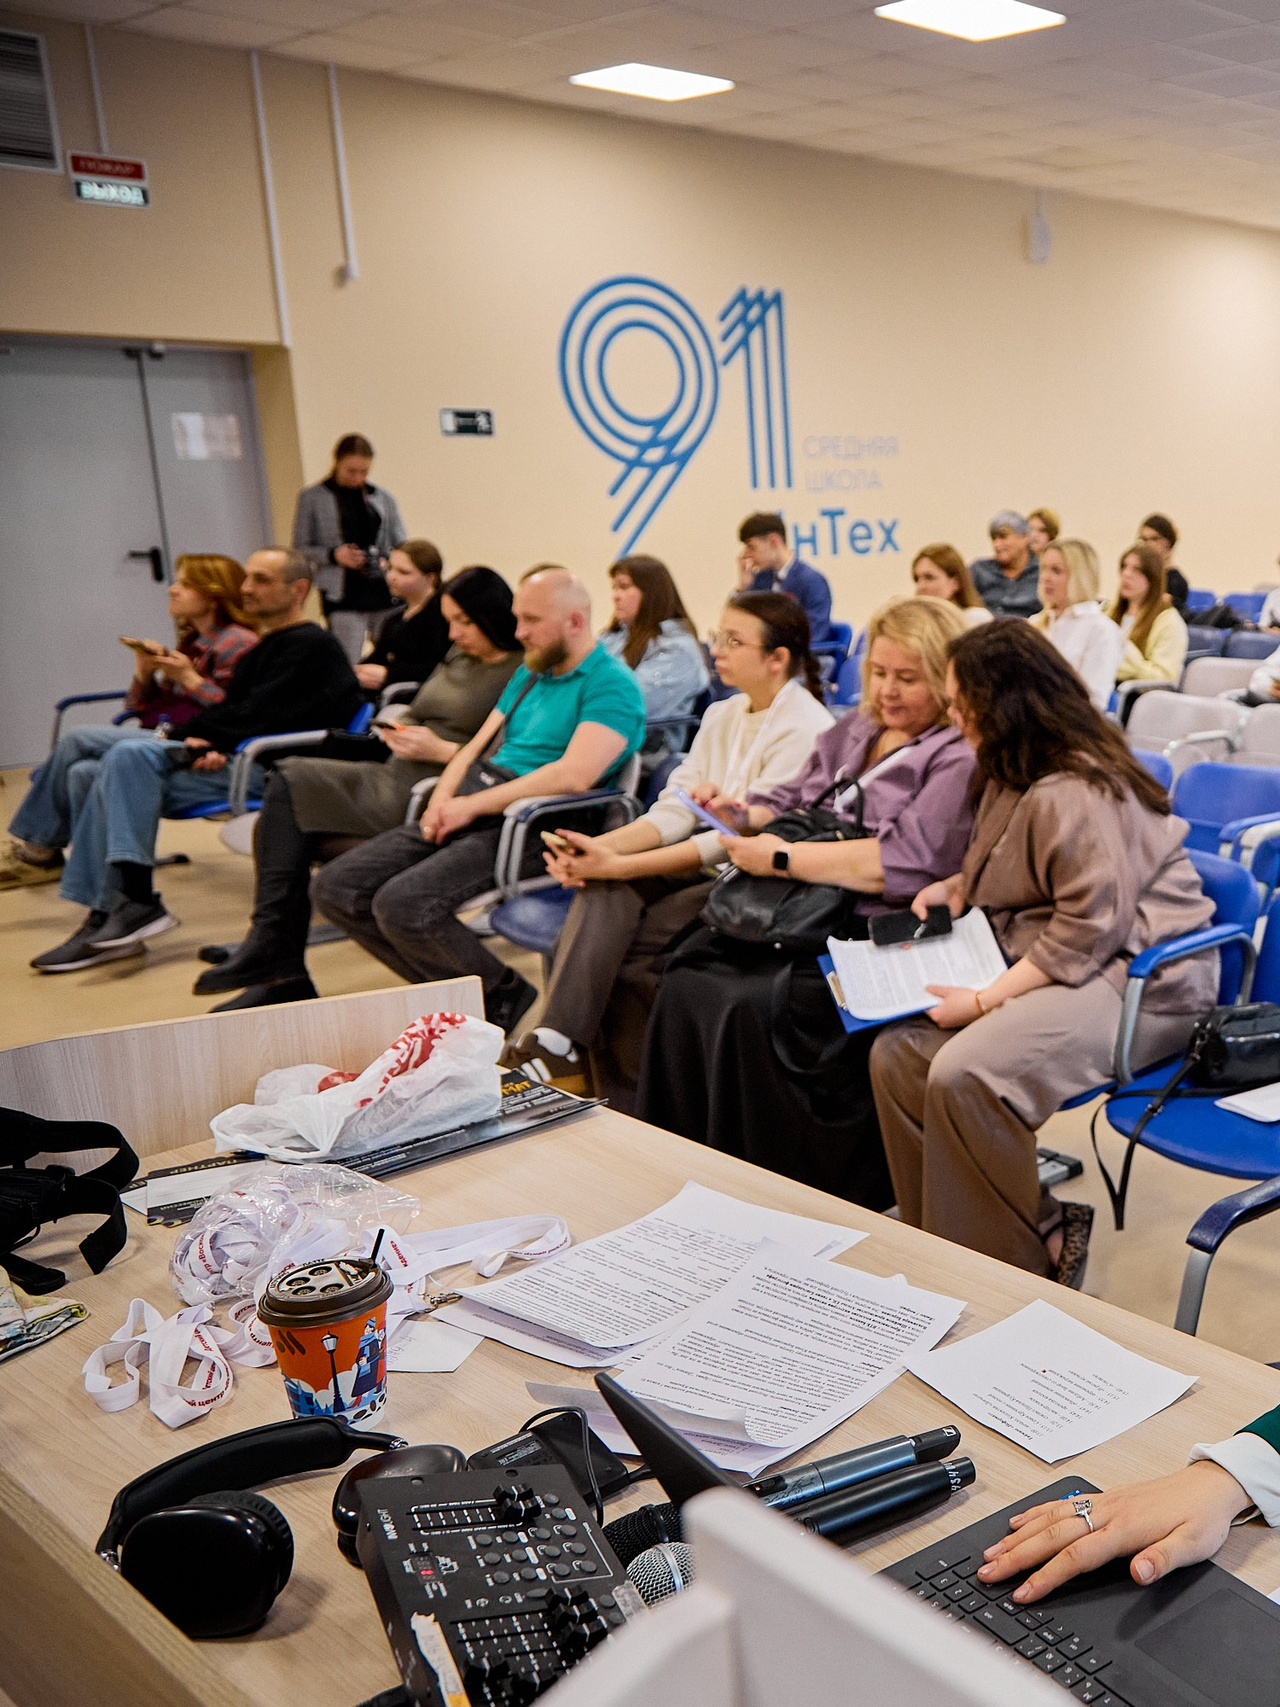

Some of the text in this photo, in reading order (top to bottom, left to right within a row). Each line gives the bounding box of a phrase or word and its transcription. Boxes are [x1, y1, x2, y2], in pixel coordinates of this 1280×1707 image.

[80, 181, 144, 205] ВЫХОД
[558, 273, 794, 563] 91
[803, 436, 899, 461] СРЕДНЯЯ
[805, 470, 882, 491] ШКОЛА
[790, 507, 901, 557] нТех
[198, 1390, 224, 1406] центр
